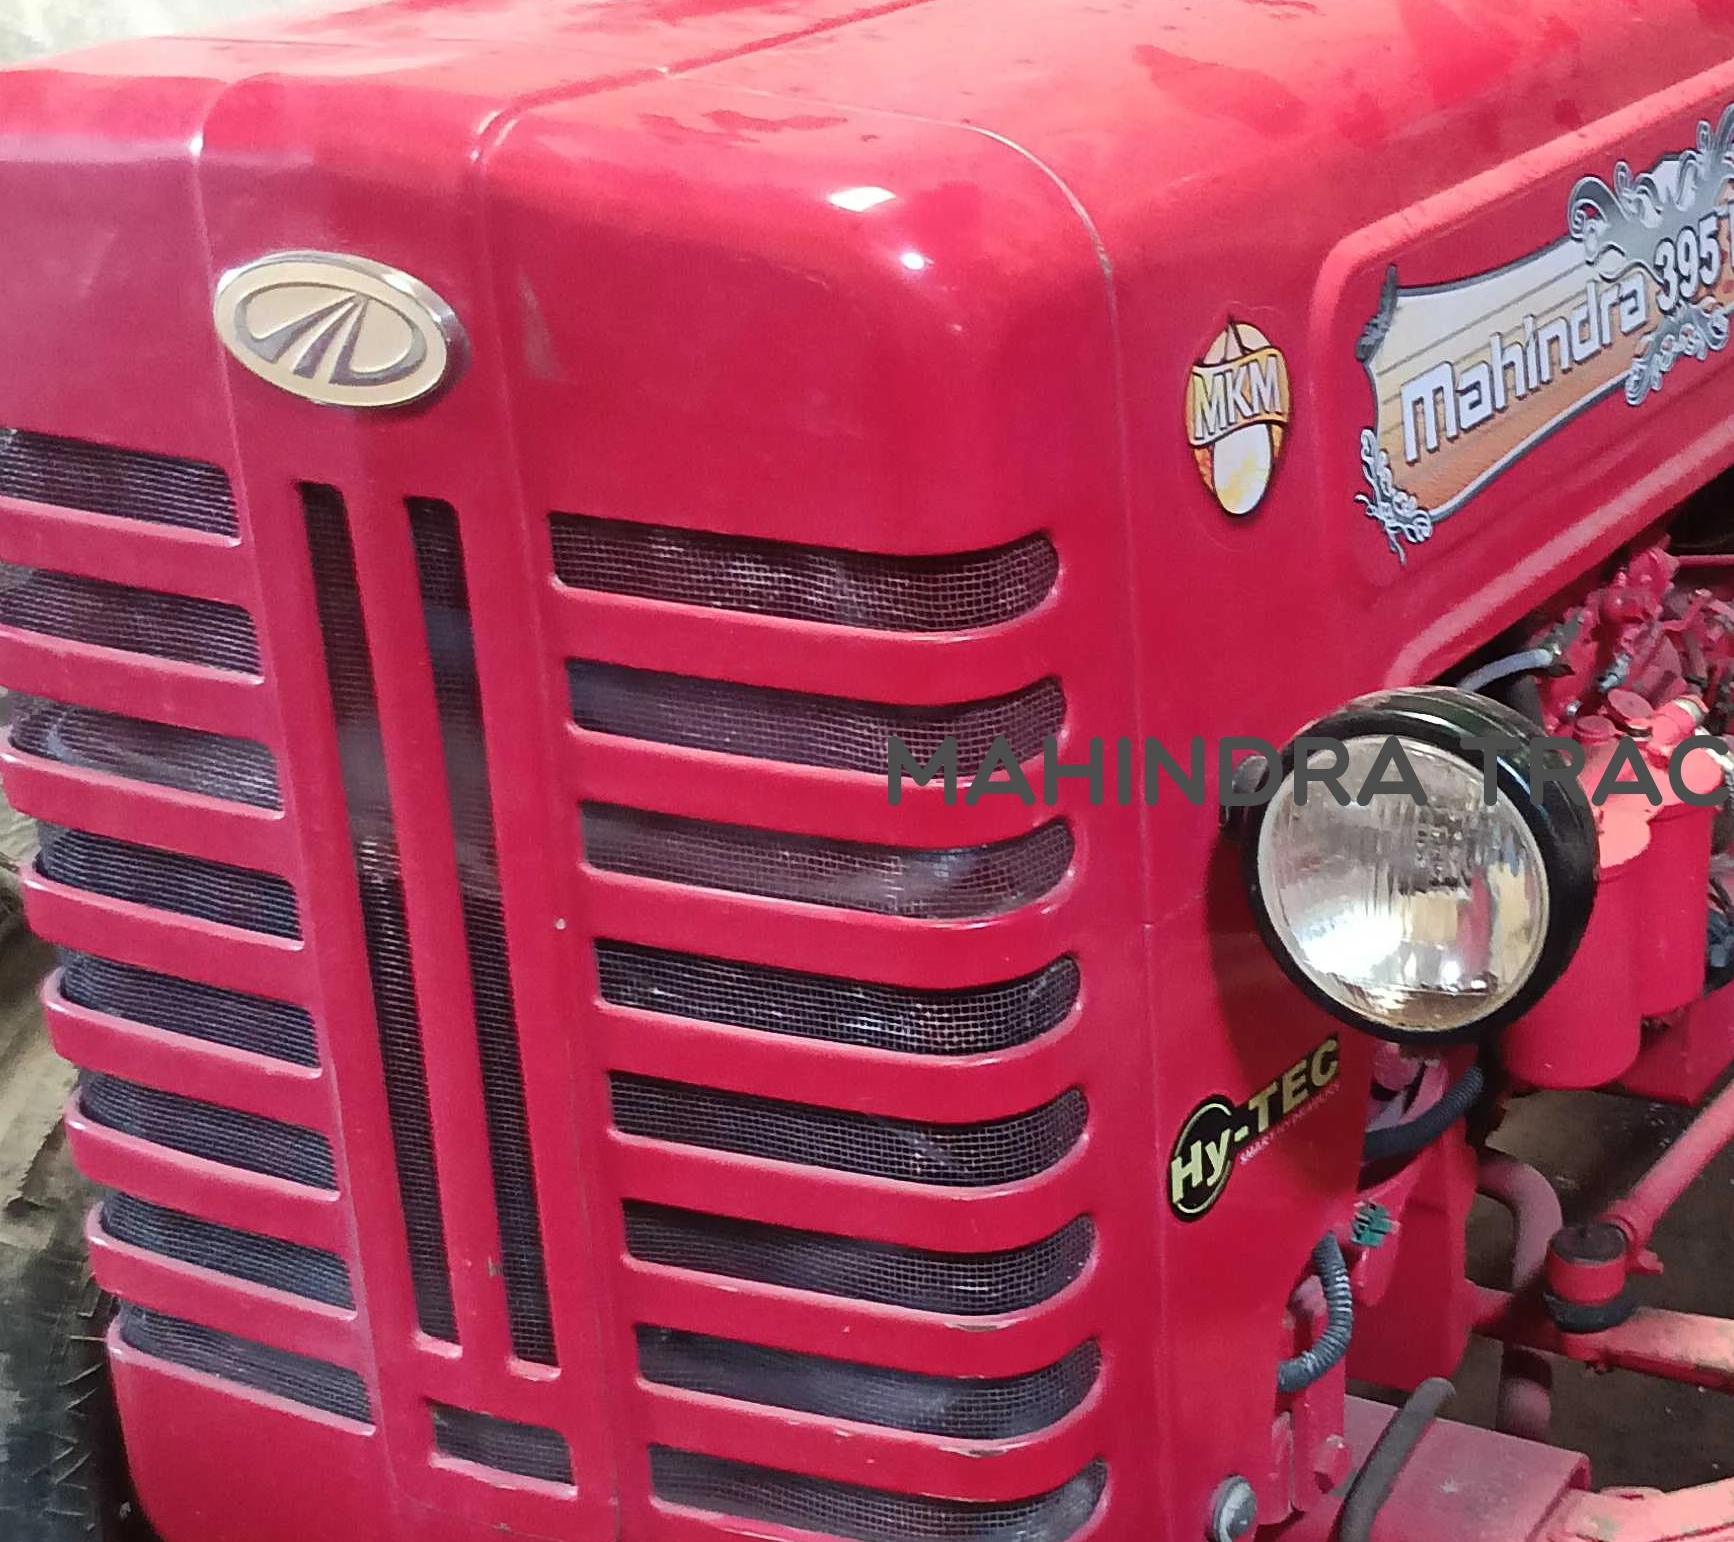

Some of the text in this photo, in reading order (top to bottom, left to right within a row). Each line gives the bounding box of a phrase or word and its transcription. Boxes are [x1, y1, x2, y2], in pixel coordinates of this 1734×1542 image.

[1192, 353, 1283, 440] MKM
[1400, 272, 1649, 465] Mahindra
[1655, 210, 1720, 316] 395
[1171, 1038, 1339, 1204] Hy-TEC
